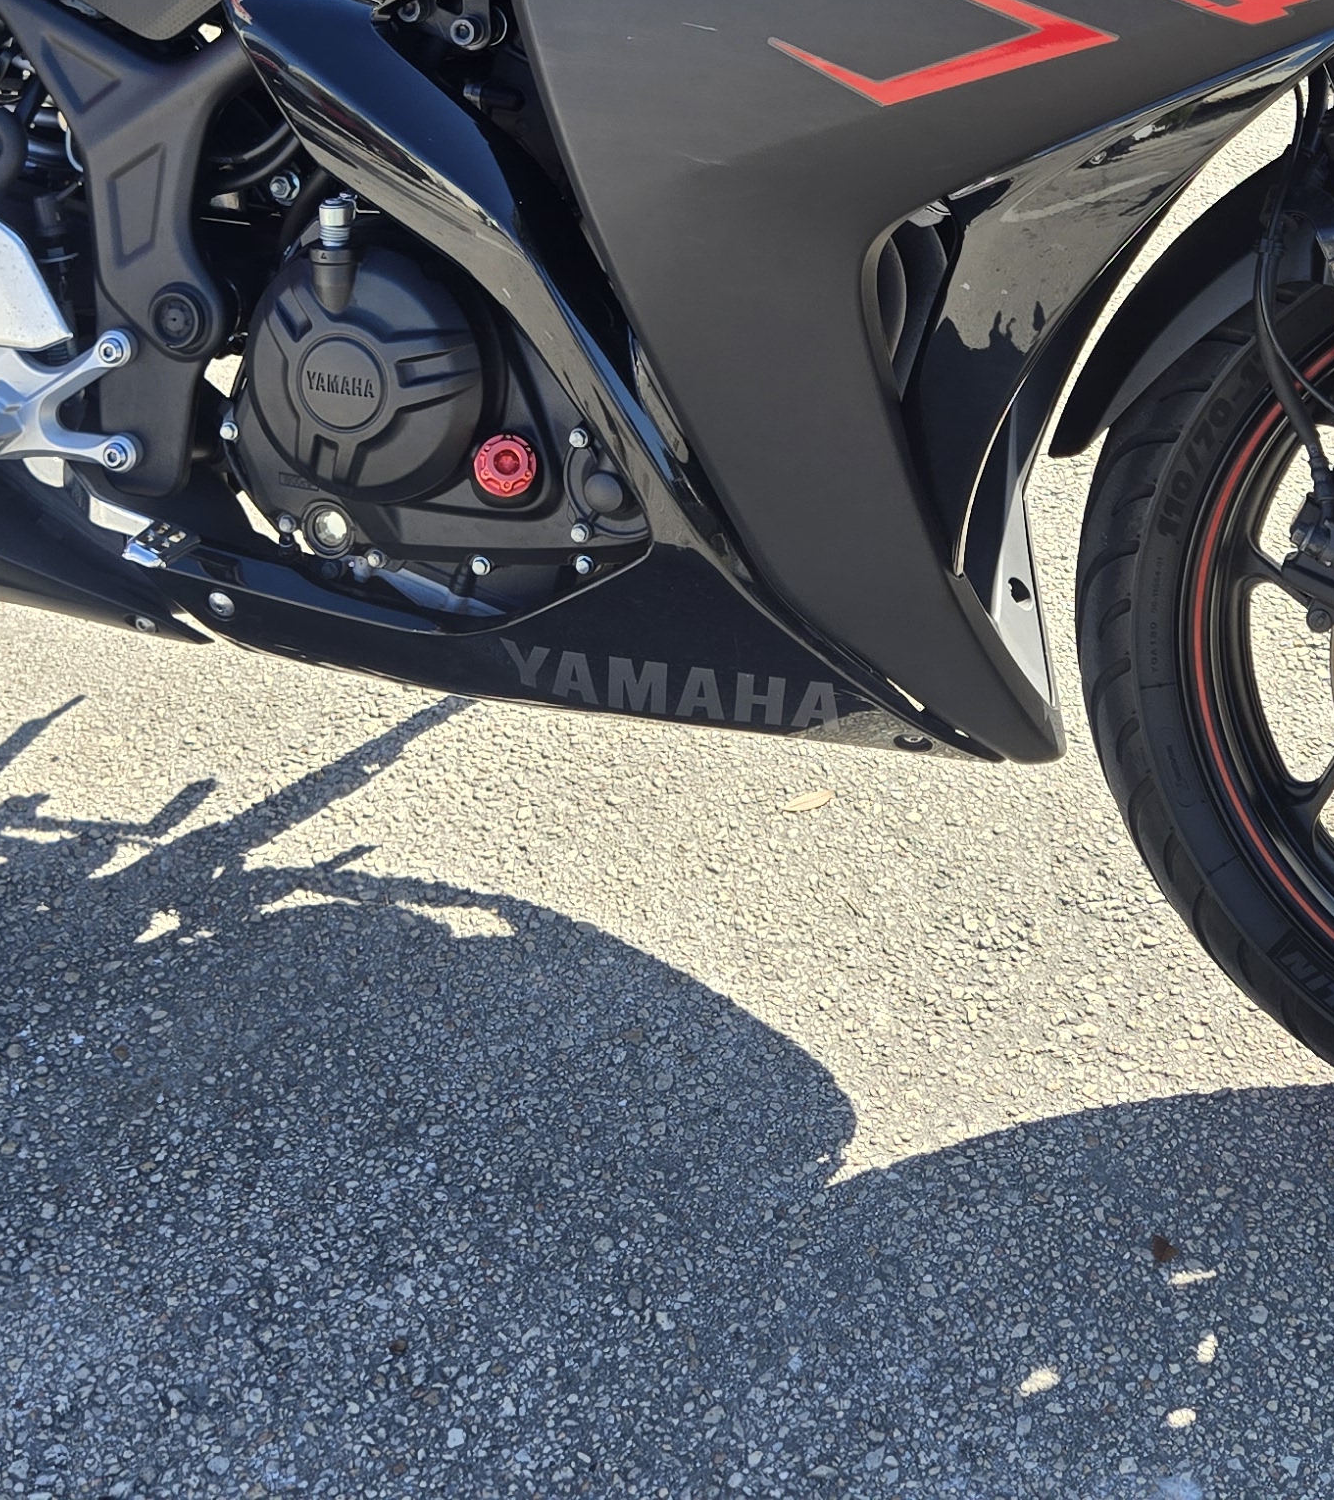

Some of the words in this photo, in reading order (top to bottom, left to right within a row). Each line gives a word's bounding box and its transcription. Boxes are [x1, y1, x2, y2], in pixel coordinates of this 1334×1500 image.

[306, 369, 376, 400] YAMAHA
[1156, 351, 1267, 537] 110/70-1
[498, 636, 842, 731] YAMAHA
